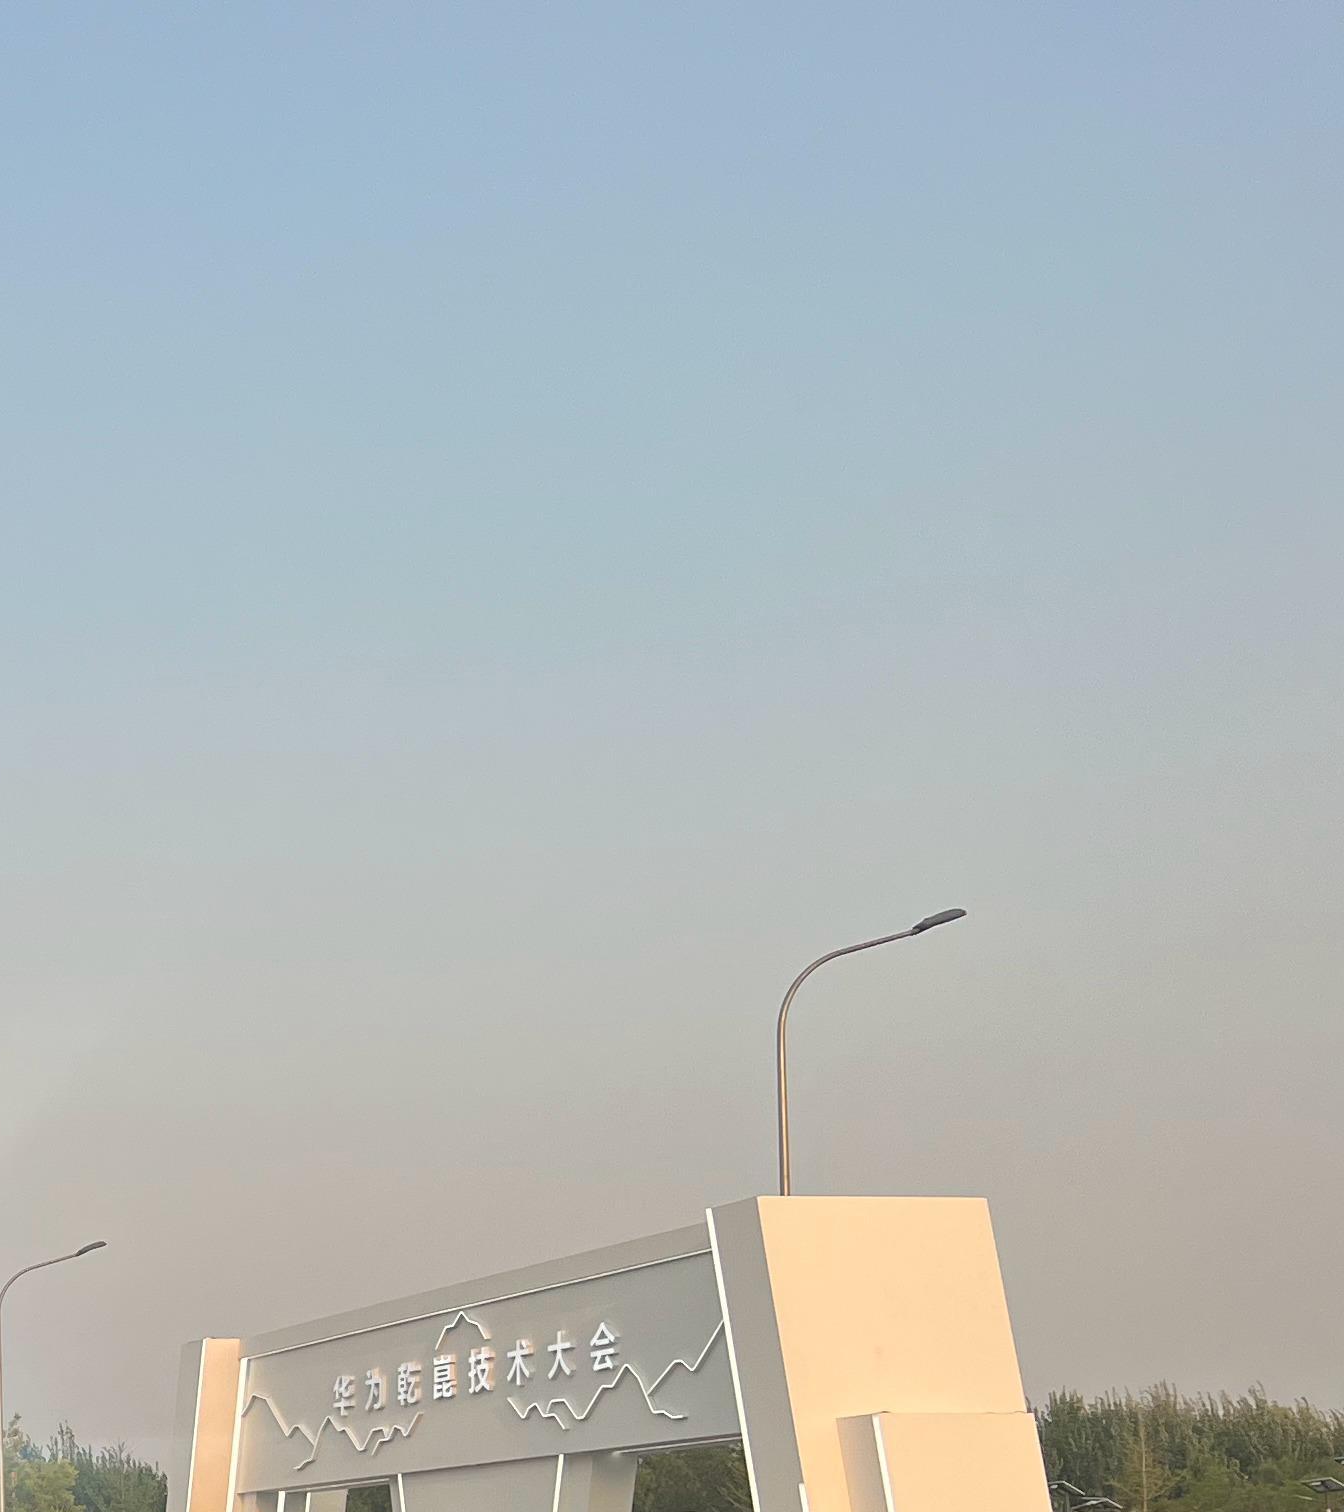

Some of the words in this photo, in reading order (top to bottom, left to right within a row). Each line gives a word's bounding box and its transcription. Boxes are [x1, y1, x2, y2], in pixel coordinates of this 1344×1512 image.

[332, 1321, 619, 1416] 华为乾崑技术大会
